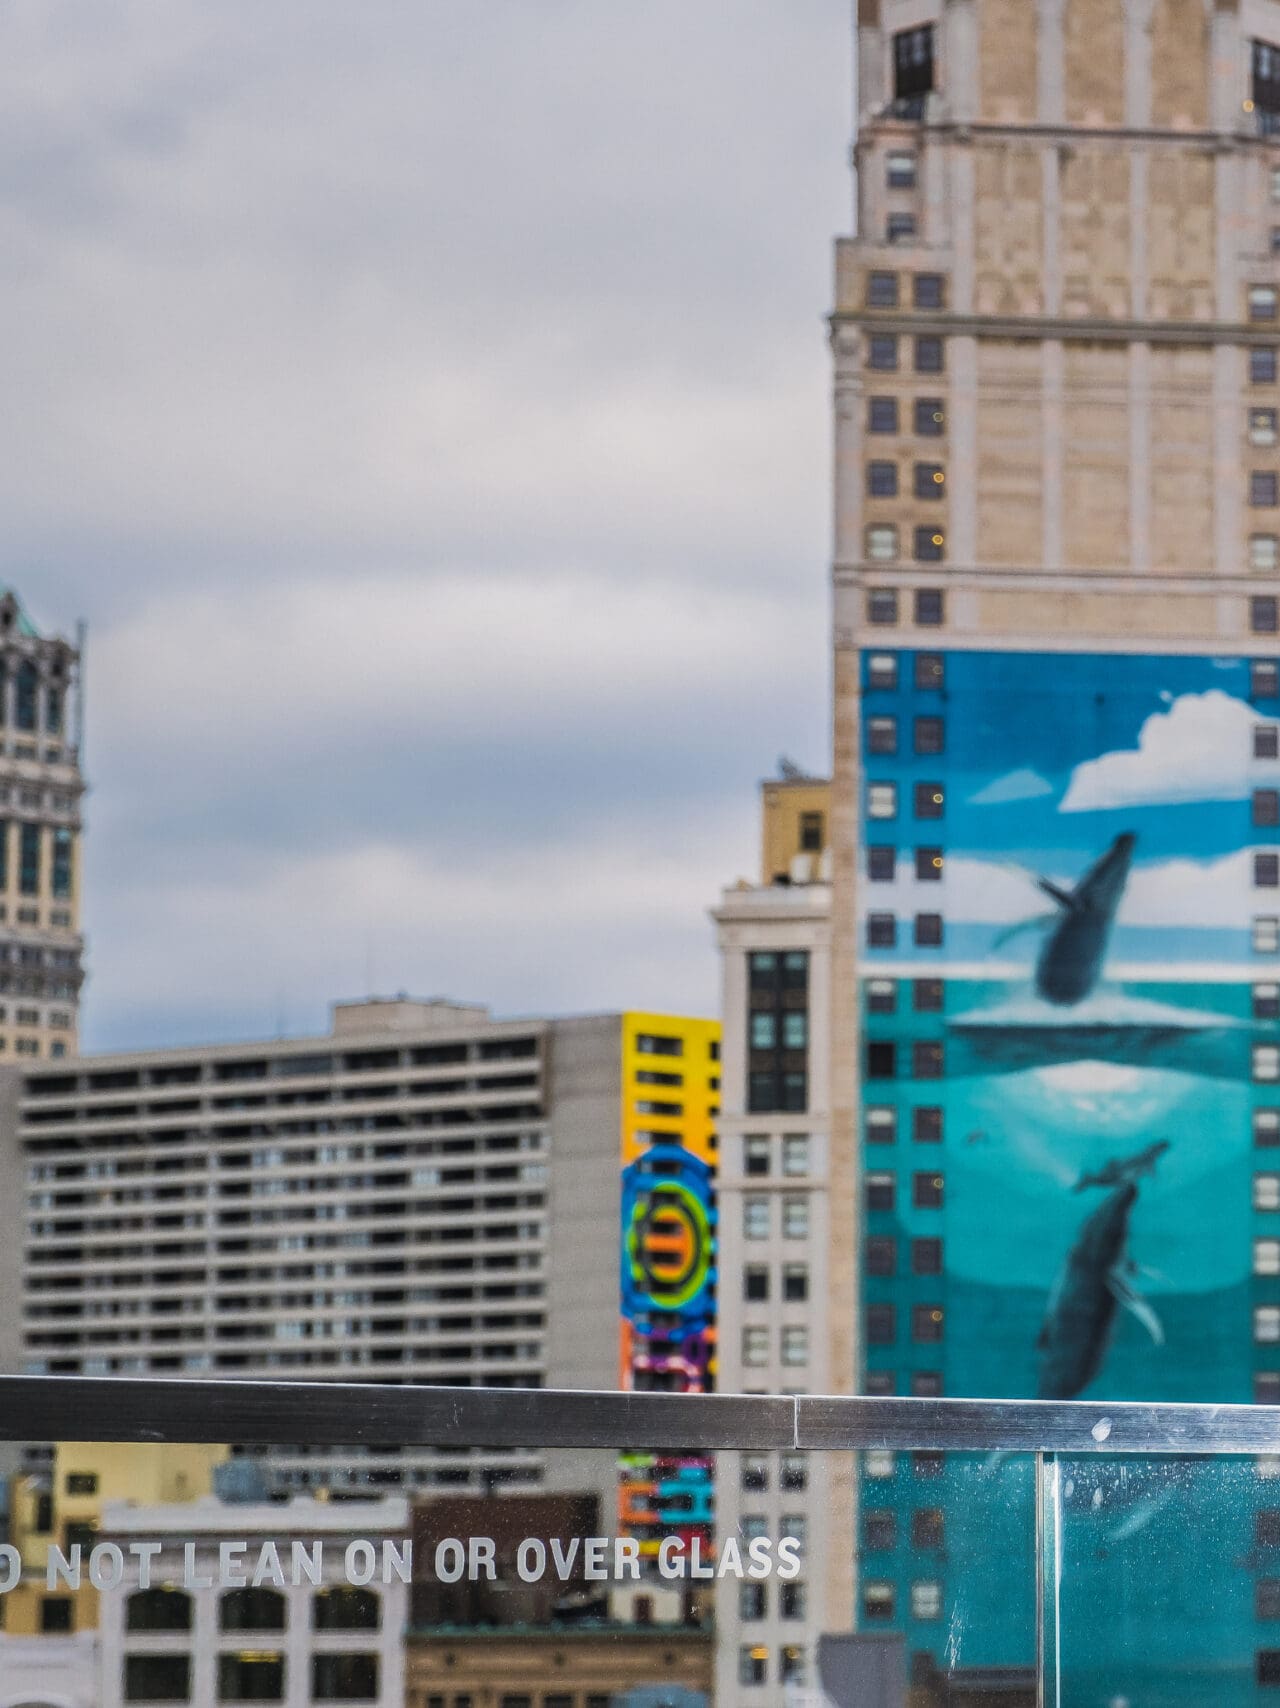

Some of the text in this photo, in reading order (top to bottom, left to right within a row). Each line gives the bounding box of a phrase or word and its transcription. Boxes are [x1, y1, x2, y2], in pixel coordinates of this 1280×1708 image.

[46, 1542, 161, 1590] NOT
[184, 1540, 324, 1587] LEAN
[345, 1540, 413, 1585] ON
[434, 1538, 496, 1582] OR
[517, 1537, 640, 1582] OVER
[659, 1536, 802, 1579] GLASS
